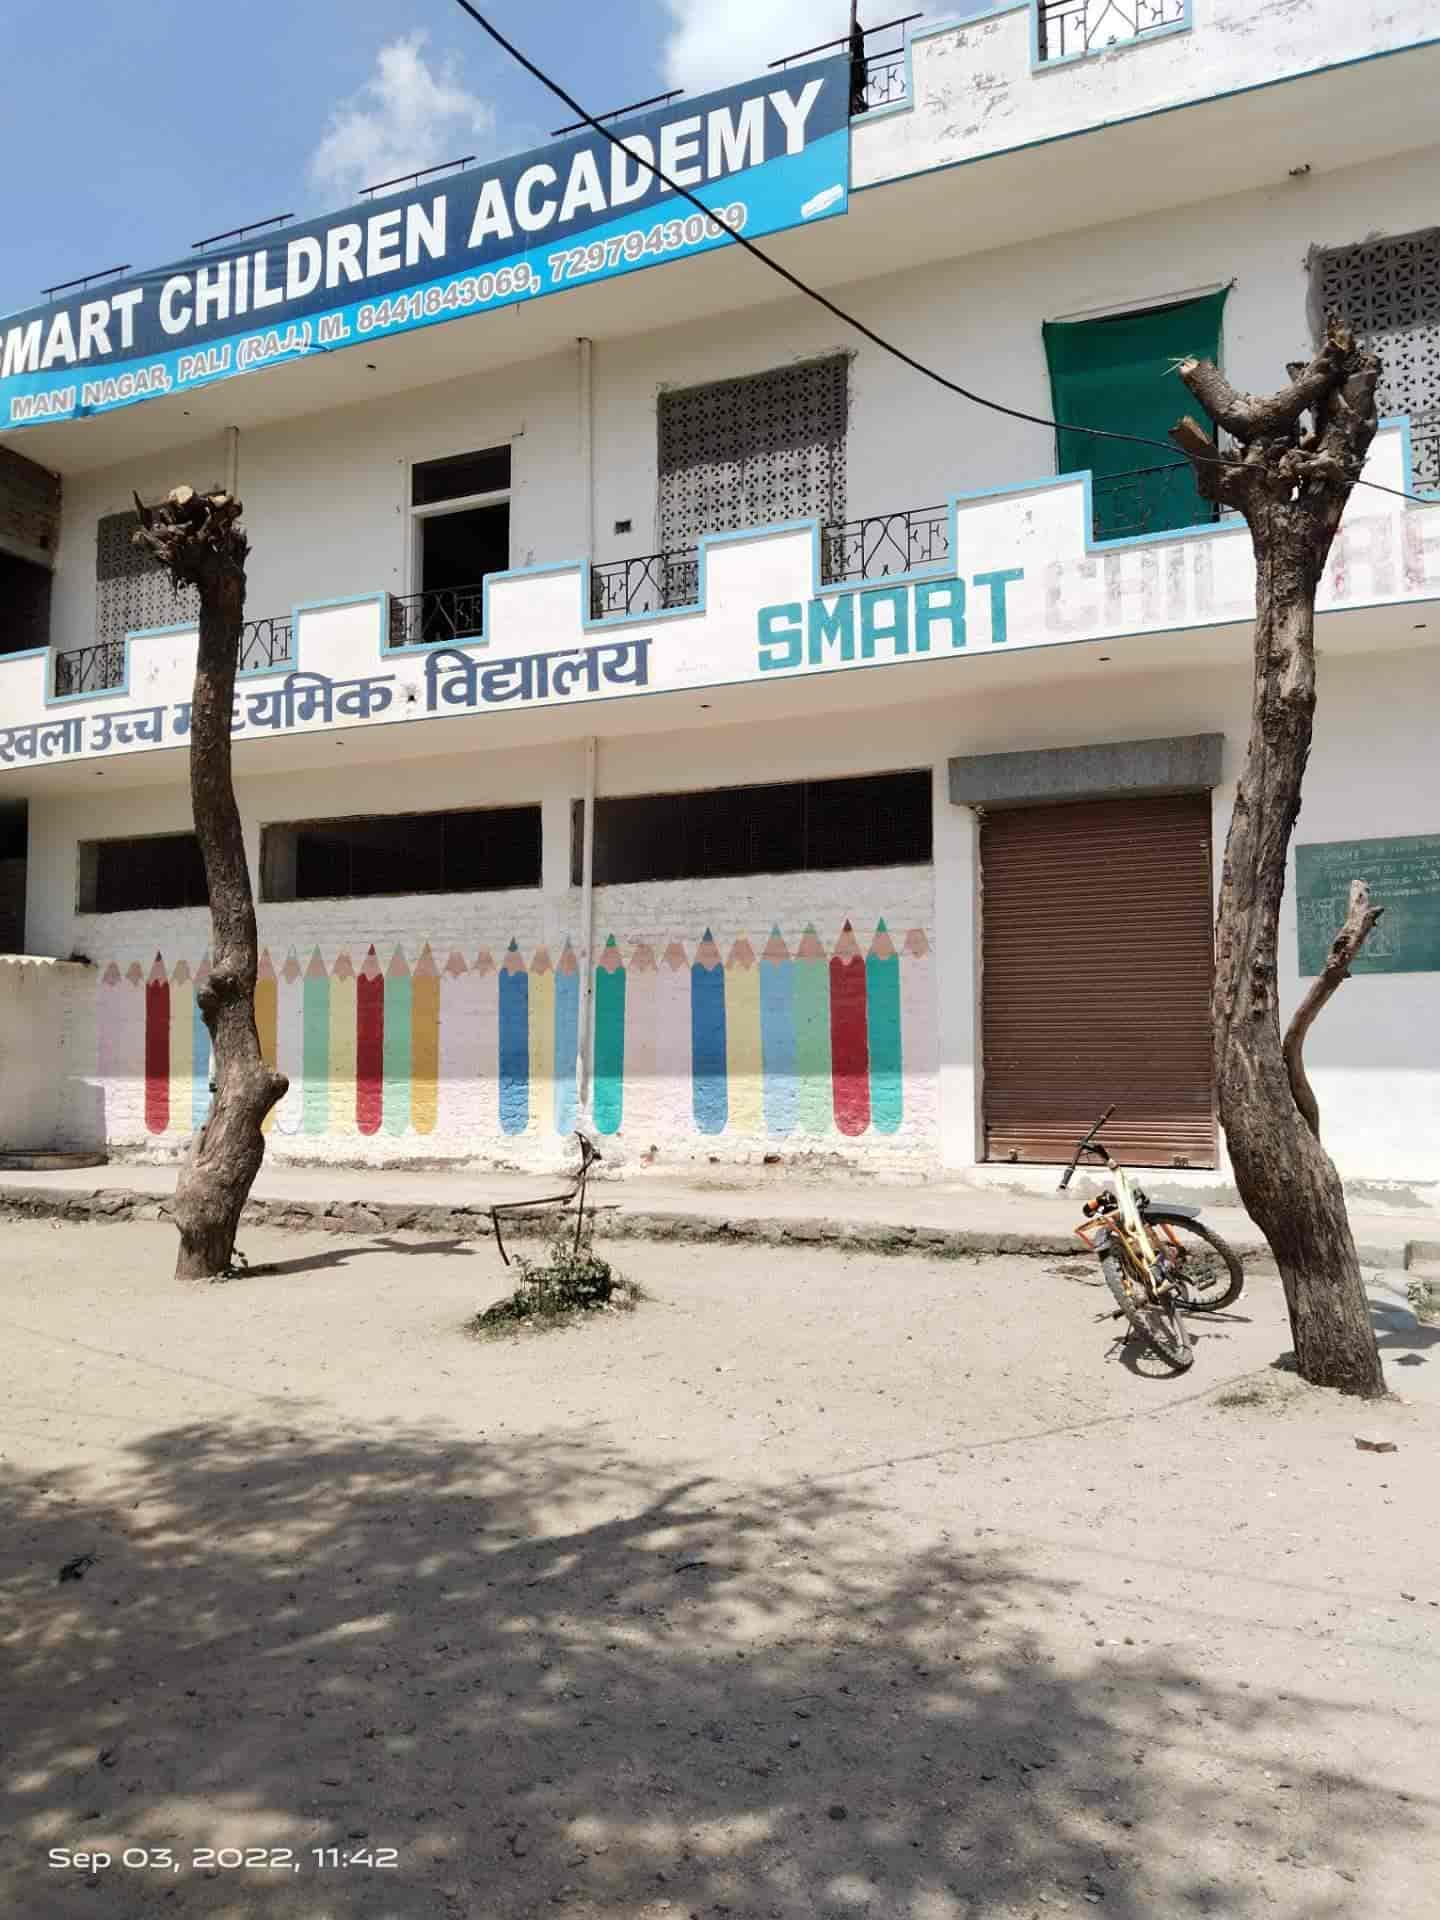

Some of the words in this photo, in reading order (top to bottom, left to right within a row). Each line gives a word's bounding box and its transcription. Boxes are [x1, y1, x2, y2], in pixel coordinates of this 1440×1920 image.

[0, 288, 144, 378] MART
[159, 195, 446, 335] CHILDREN
[467, 78, 825, 249] ACADEMY
[10, 386, 76, 420] MANI
[82, 364, 172, 407] NAGAR,
[178, 344, 231, 383] PALI
[236, 323, 312, 369] (RAJ.)
[319, 312, 350, 343] M.
[357, 262, 541, 334] 8441843069,
[548, 201, 748, 282] 7297943069
[91, 705, 167, 752] उच्च
[424, 637, 653, 712] विद्यालय
[757, 568, 1025, 672] SMART
